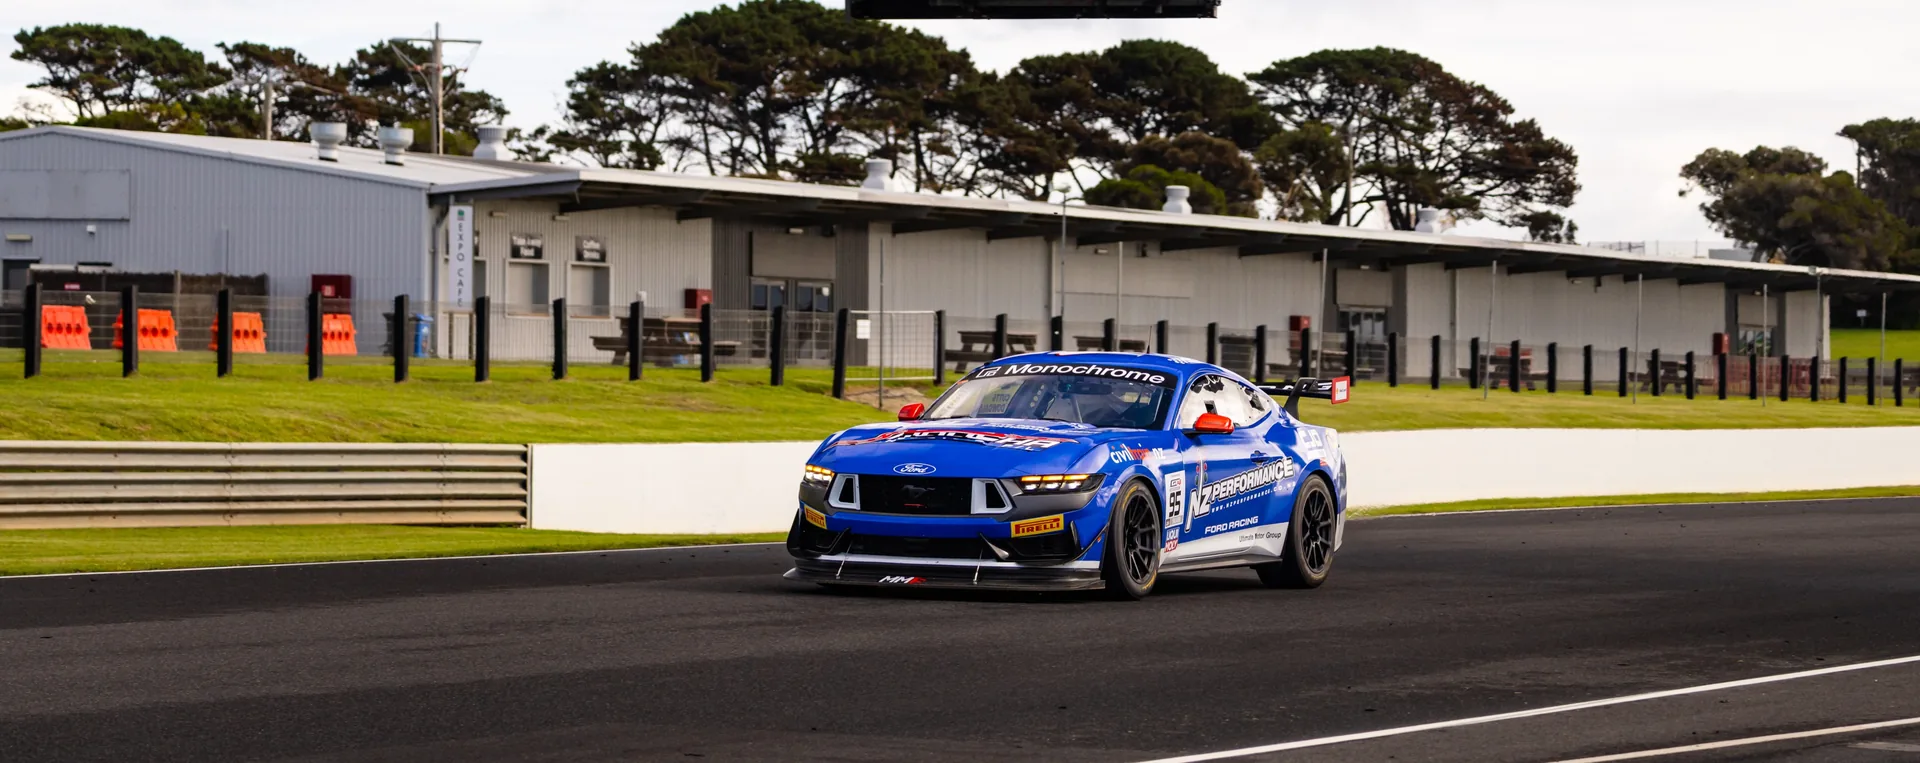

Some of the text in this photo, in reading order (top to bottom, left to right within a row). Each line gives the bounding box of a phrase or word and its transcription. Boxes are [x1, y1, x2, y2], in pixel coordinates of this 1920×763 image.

[456, 222, 465, 262] EXPO
[1004, 363, 1165, 384] Monochrome
[898, 464, 931, 474] Ford
[1168, 491, 1181, 517] 95
[1014, 517, 1061, 535] PIRELLI
[1205, 516, 1259, 534] FORD RACING
[1266, 531, 1281, 540] Group
